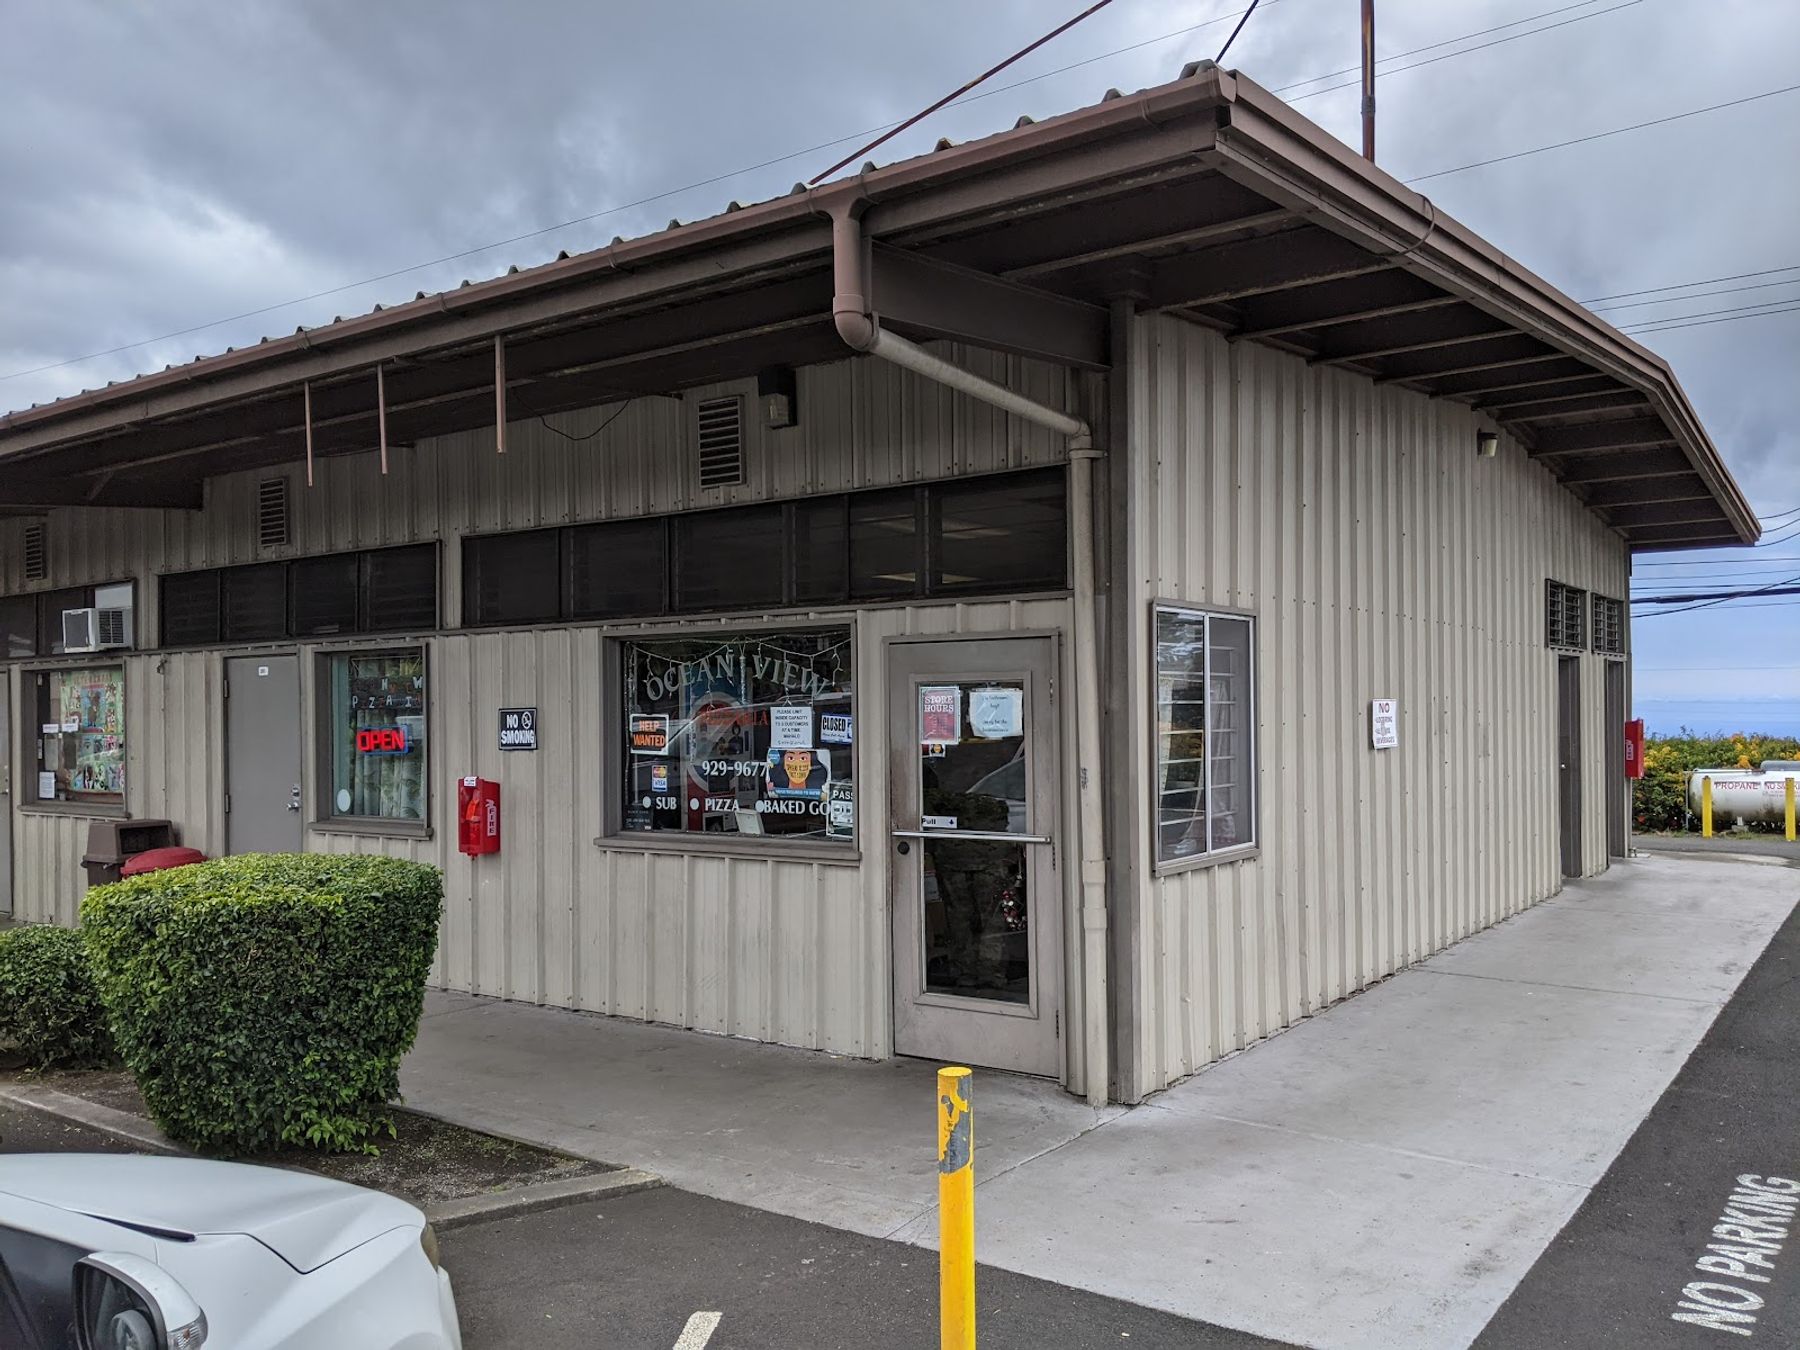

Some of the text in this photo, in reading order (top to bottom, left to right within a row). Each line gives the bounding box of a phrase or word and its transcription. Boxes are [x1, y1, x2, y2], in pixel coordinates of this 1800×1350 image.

[646, 654, 829, 700] OCEAN VIEW
[924, 695, 953, 704] STORE
[924, 704, 954, 713] HOURS
[1379, 702, 1390, 713] NO
[506, 714, 519, 728] NO
[823, 716, 846, 732] CLOSED
[357, 729, 405, 751] OPEN
[501, 730, 535, 744] SMOKING
[633, 734, 665, 747] WANTED
[702, 760, 768, 777] 929-9677
[1714, 781, 1760, 790] PROPANE
[655, 796, 677, 810] SUB
[704, 798, 740, 812] PIZZA
[764, 799, 806, 814] BAKED
[488, 808, 496, 834] FIRE
[921, 817, 936, 825] Pull
[1671, 1174, 1800, 1336] NO PARKING
